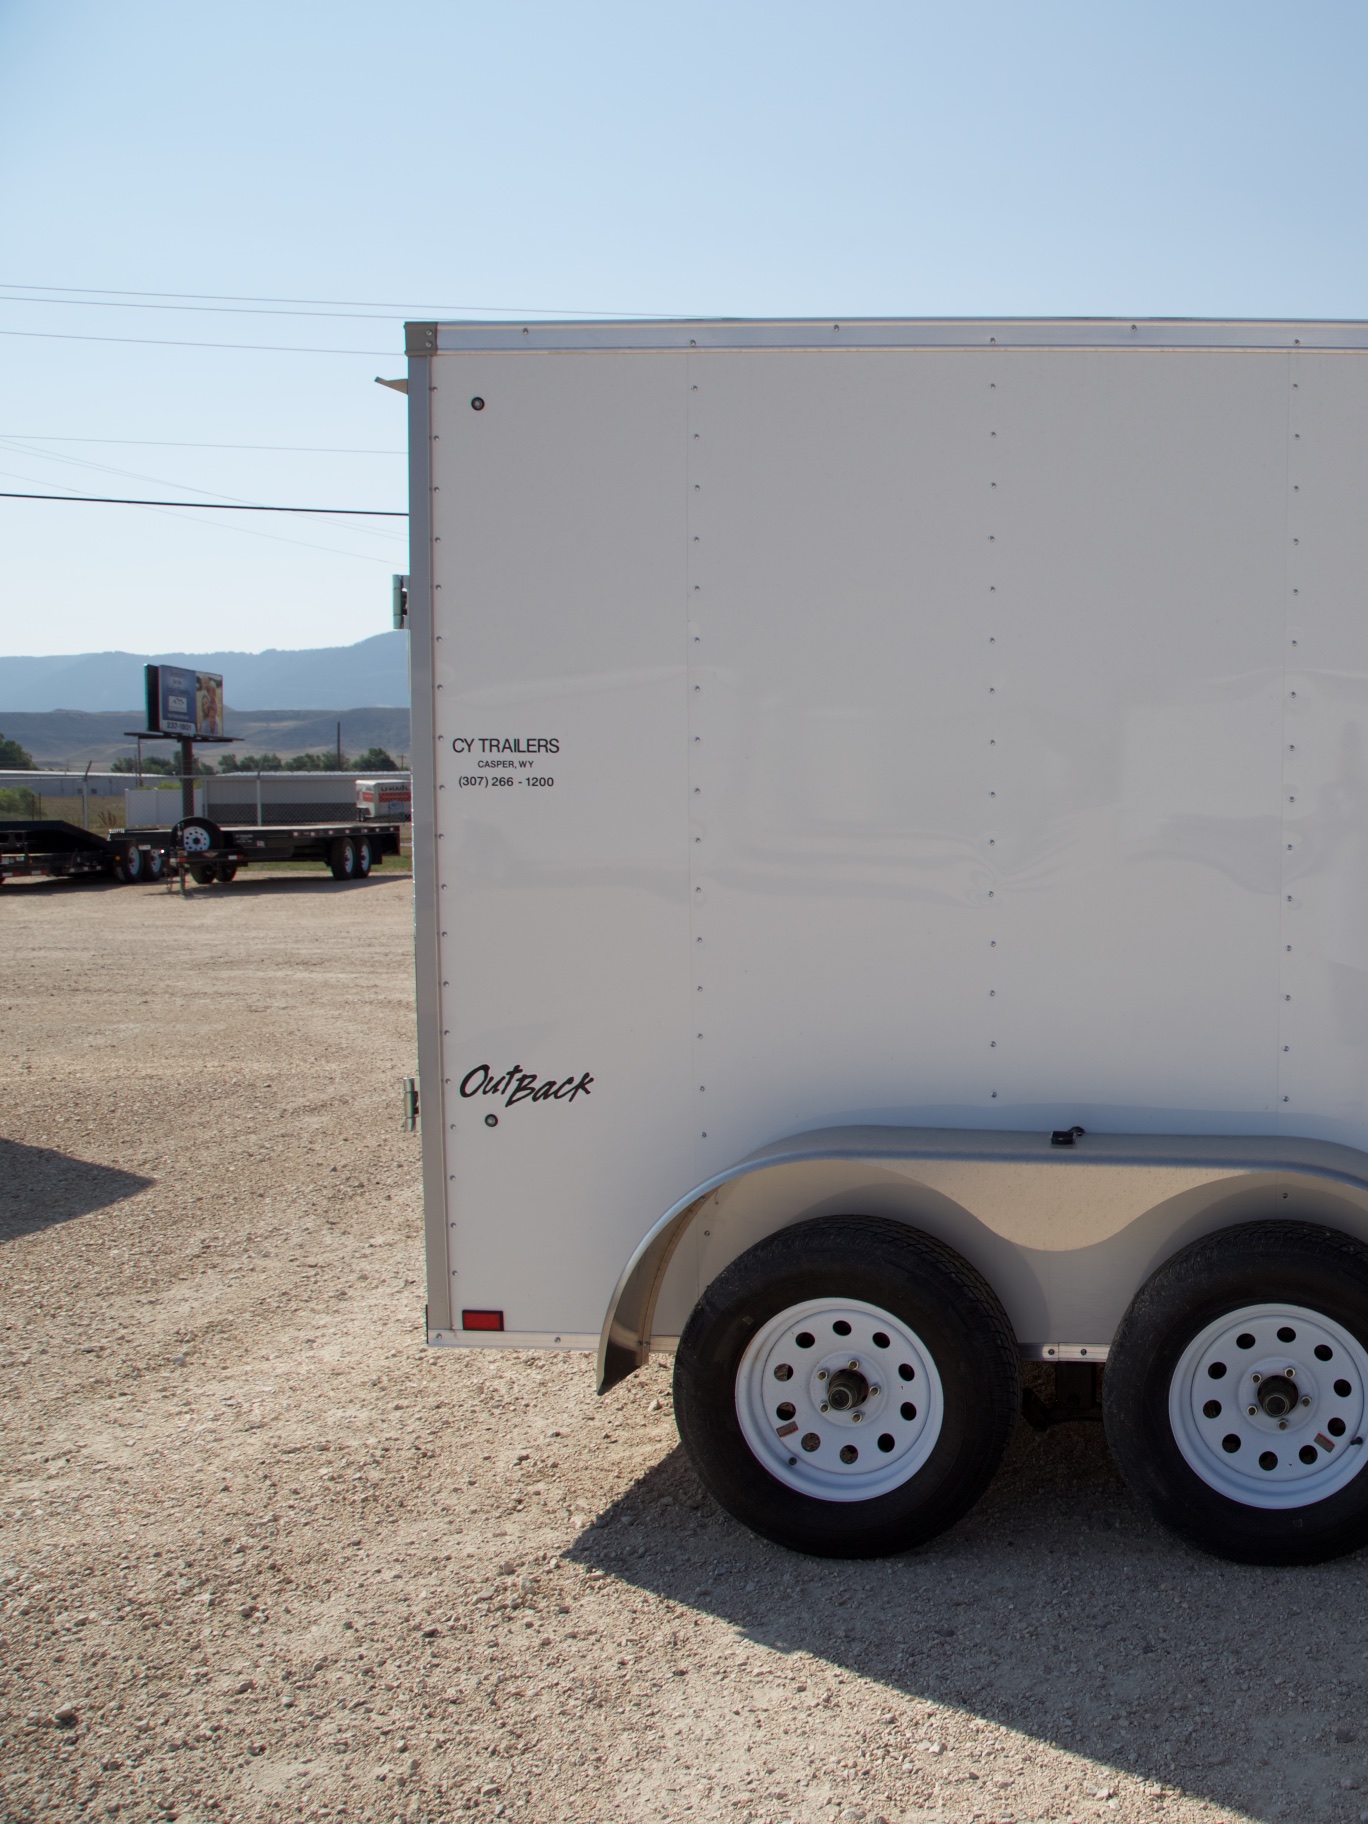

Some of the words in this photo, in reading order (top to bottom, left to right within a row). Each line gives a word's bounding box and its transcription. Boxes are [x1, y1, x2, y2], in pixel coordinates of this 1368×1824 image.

[452, 737, 475, 753] CY
[478, 738, 560, 753] TRAILERS
[477, 760, 517, 769] CASPER,
[518, 760, 534, 768] WY
[458, 776, 489, 788] (307)
[491, 777, 514, 787] 266
[525, 777, 554, 787] 1200
